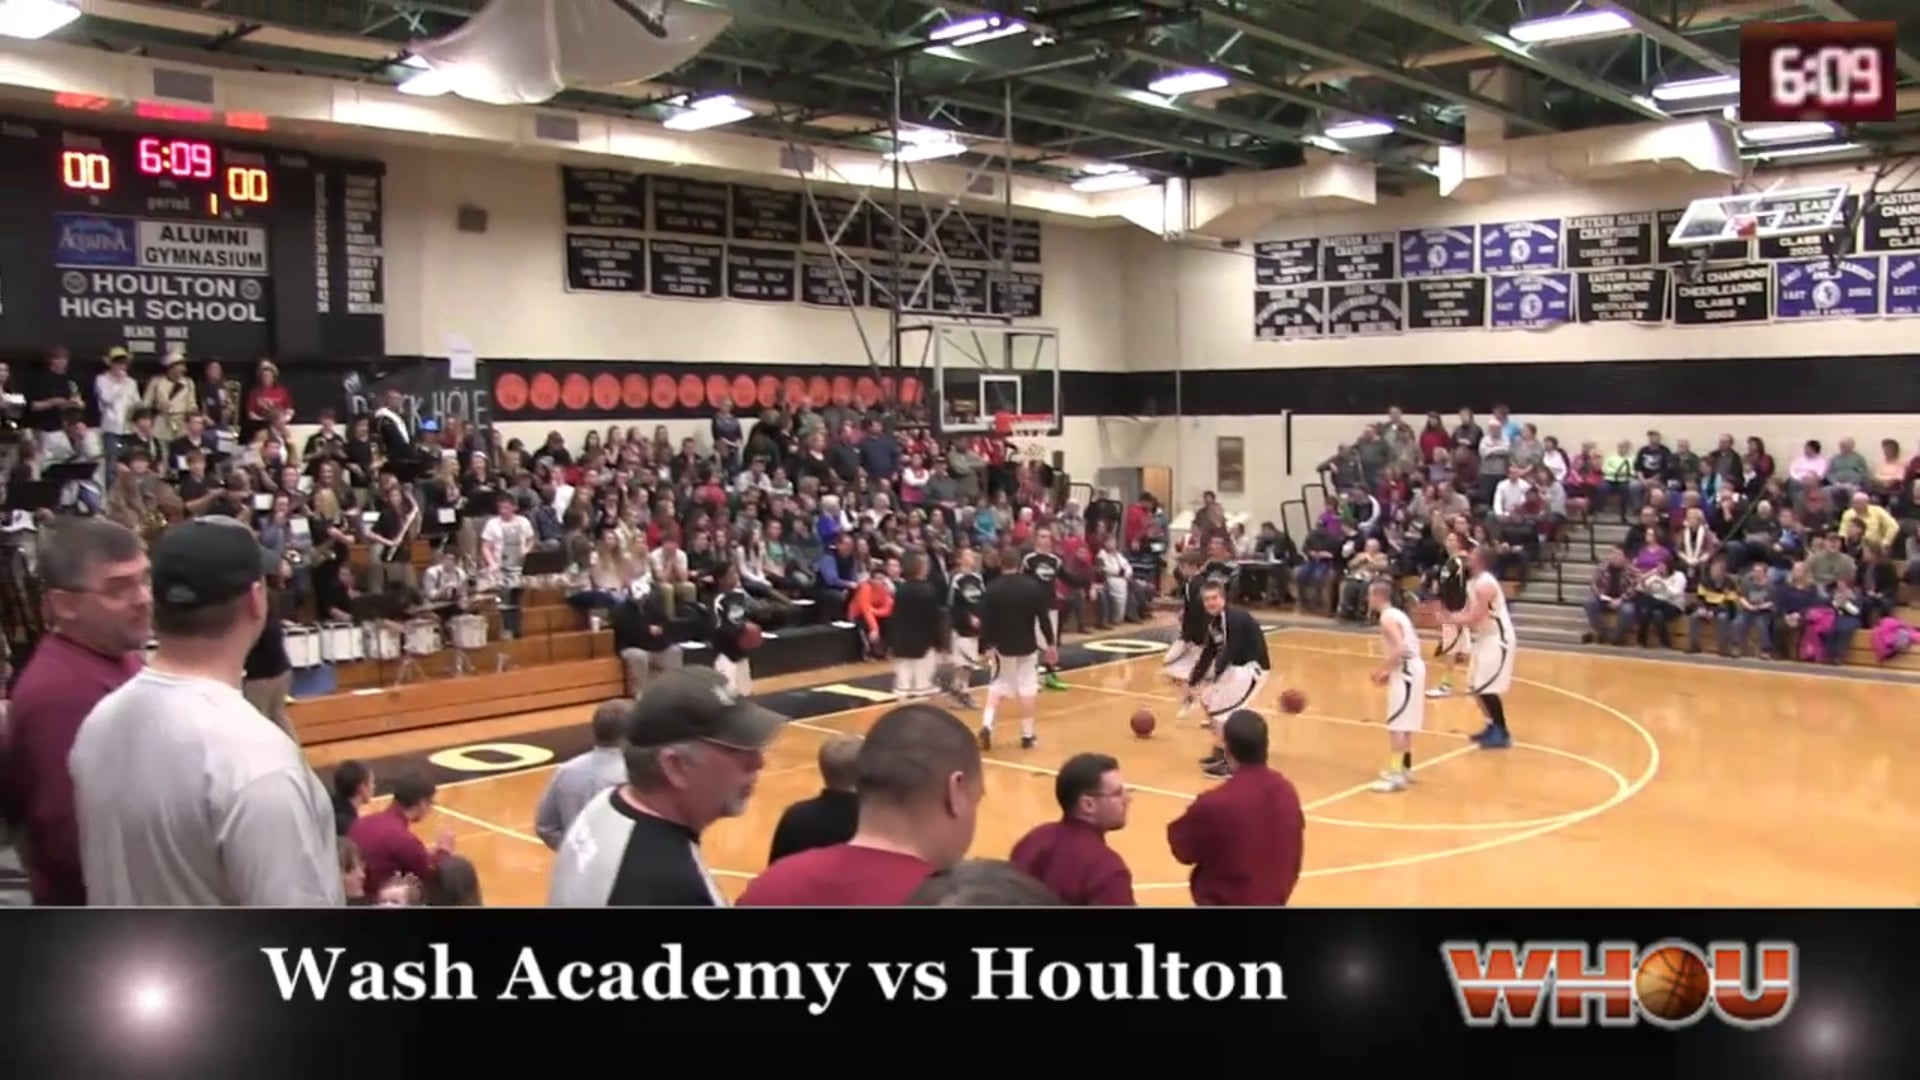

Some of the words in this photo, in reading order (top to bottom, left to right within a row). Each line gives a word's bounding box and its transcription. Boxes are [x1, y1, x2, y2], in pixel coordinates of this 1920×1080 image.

[63, 152, 111, 190] 00
[139, 139, 212, 178] 6:09
[228, 167, 268, 203] 00
[210, 192, 219, 216] 1
[160, 225, 248, 247] ALUMNI
[145, 246, 263, 268] GYMNASIUM
[92, 272, 236, 298] HOULTON
[1707, 266, 1768, 283] CHAMPIONS
[1679, 281, 1763, 297] CHEERLEADING
[60, 297, 135, 320] HIGH
[145, 299, 266, 323] SCHOOL
